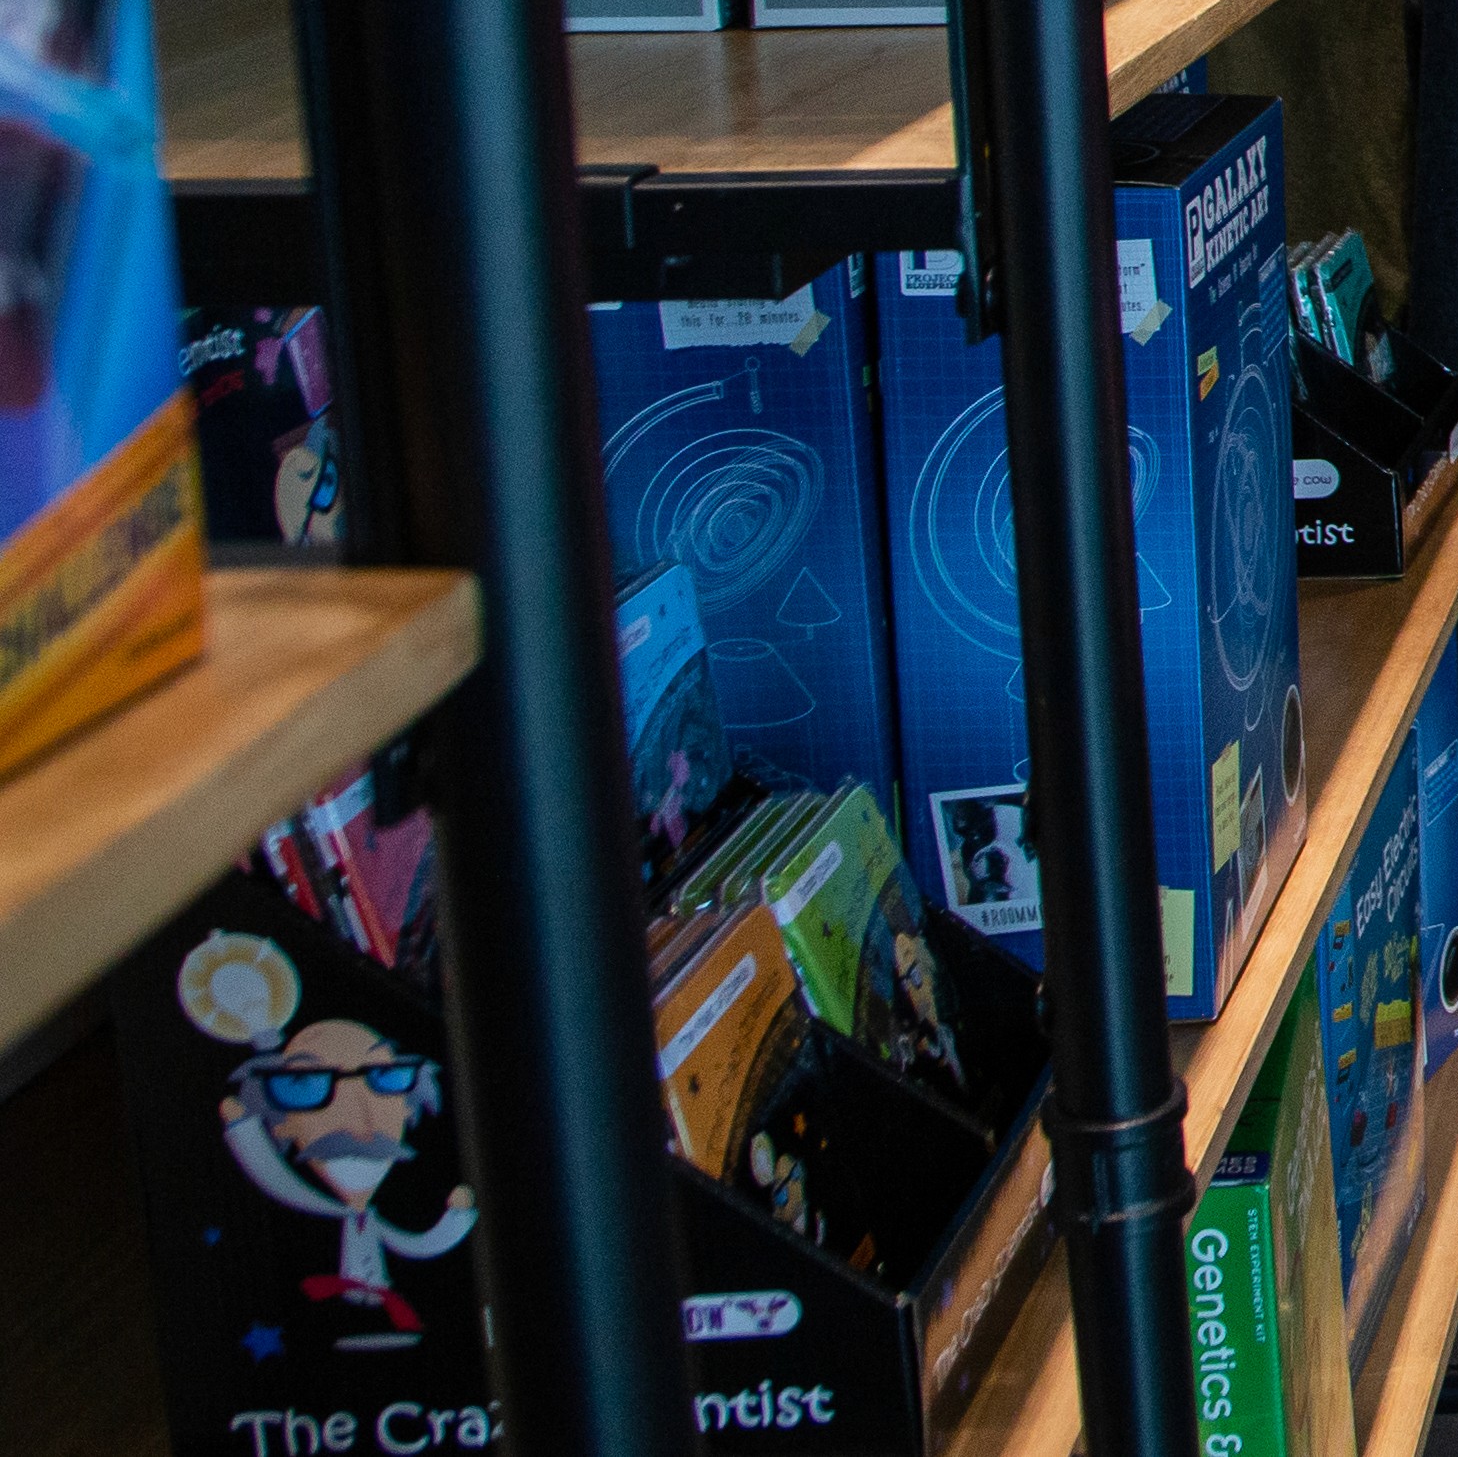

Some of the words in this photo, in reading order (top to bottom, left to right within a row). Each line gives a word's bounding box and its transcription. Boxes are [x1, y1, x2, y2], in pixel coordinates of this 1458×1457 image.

[1203, 135, 1268, 234] GALAXY
[1205, 205, 1251, 274] KINETIC
[1250, 184, 1270, 230] ART
[1356, 866, 1384, 940] Easy
[1247, 1208, 1259, 1242] STEM
[1250, 1244, 1265, 1321] EXPERIMENT
[1190, 1227, 1237, 1422] Genetics
[1255, 1322, 1267, 1343] KIT
[230, 1408, 358, 1457] The
[376, 1401, 502, 1456] Cra
[694, 1380, 836, 1433] ntist
[1204, 1433, 1243, 1457] &
